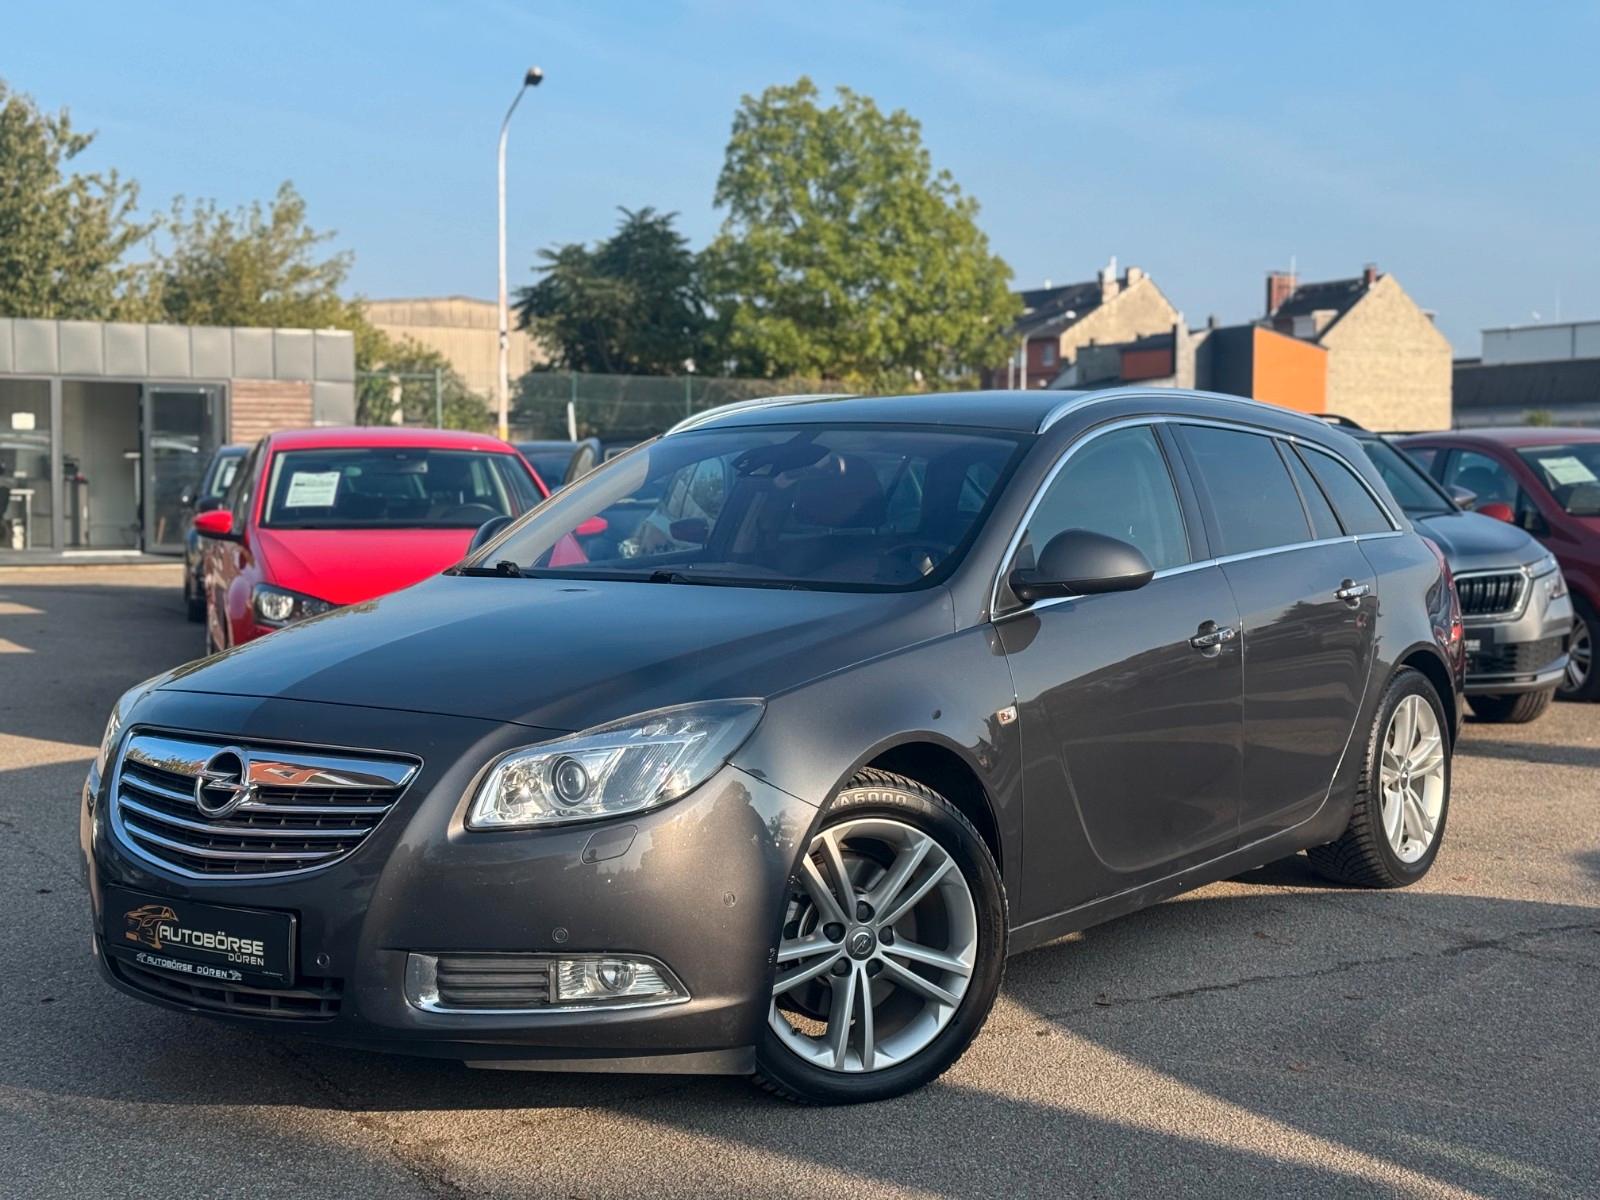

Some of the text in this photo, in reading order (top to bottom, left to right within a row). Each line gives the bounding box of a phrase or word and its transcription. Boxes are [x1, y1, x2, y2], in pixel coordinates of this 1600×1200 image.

[159, 925, 264, 956] AUTOBÖRSE
[146, 955, 228, 978] AUTOBÖRSE DÜREN
[227, 951, 264, 967] DÜREN
